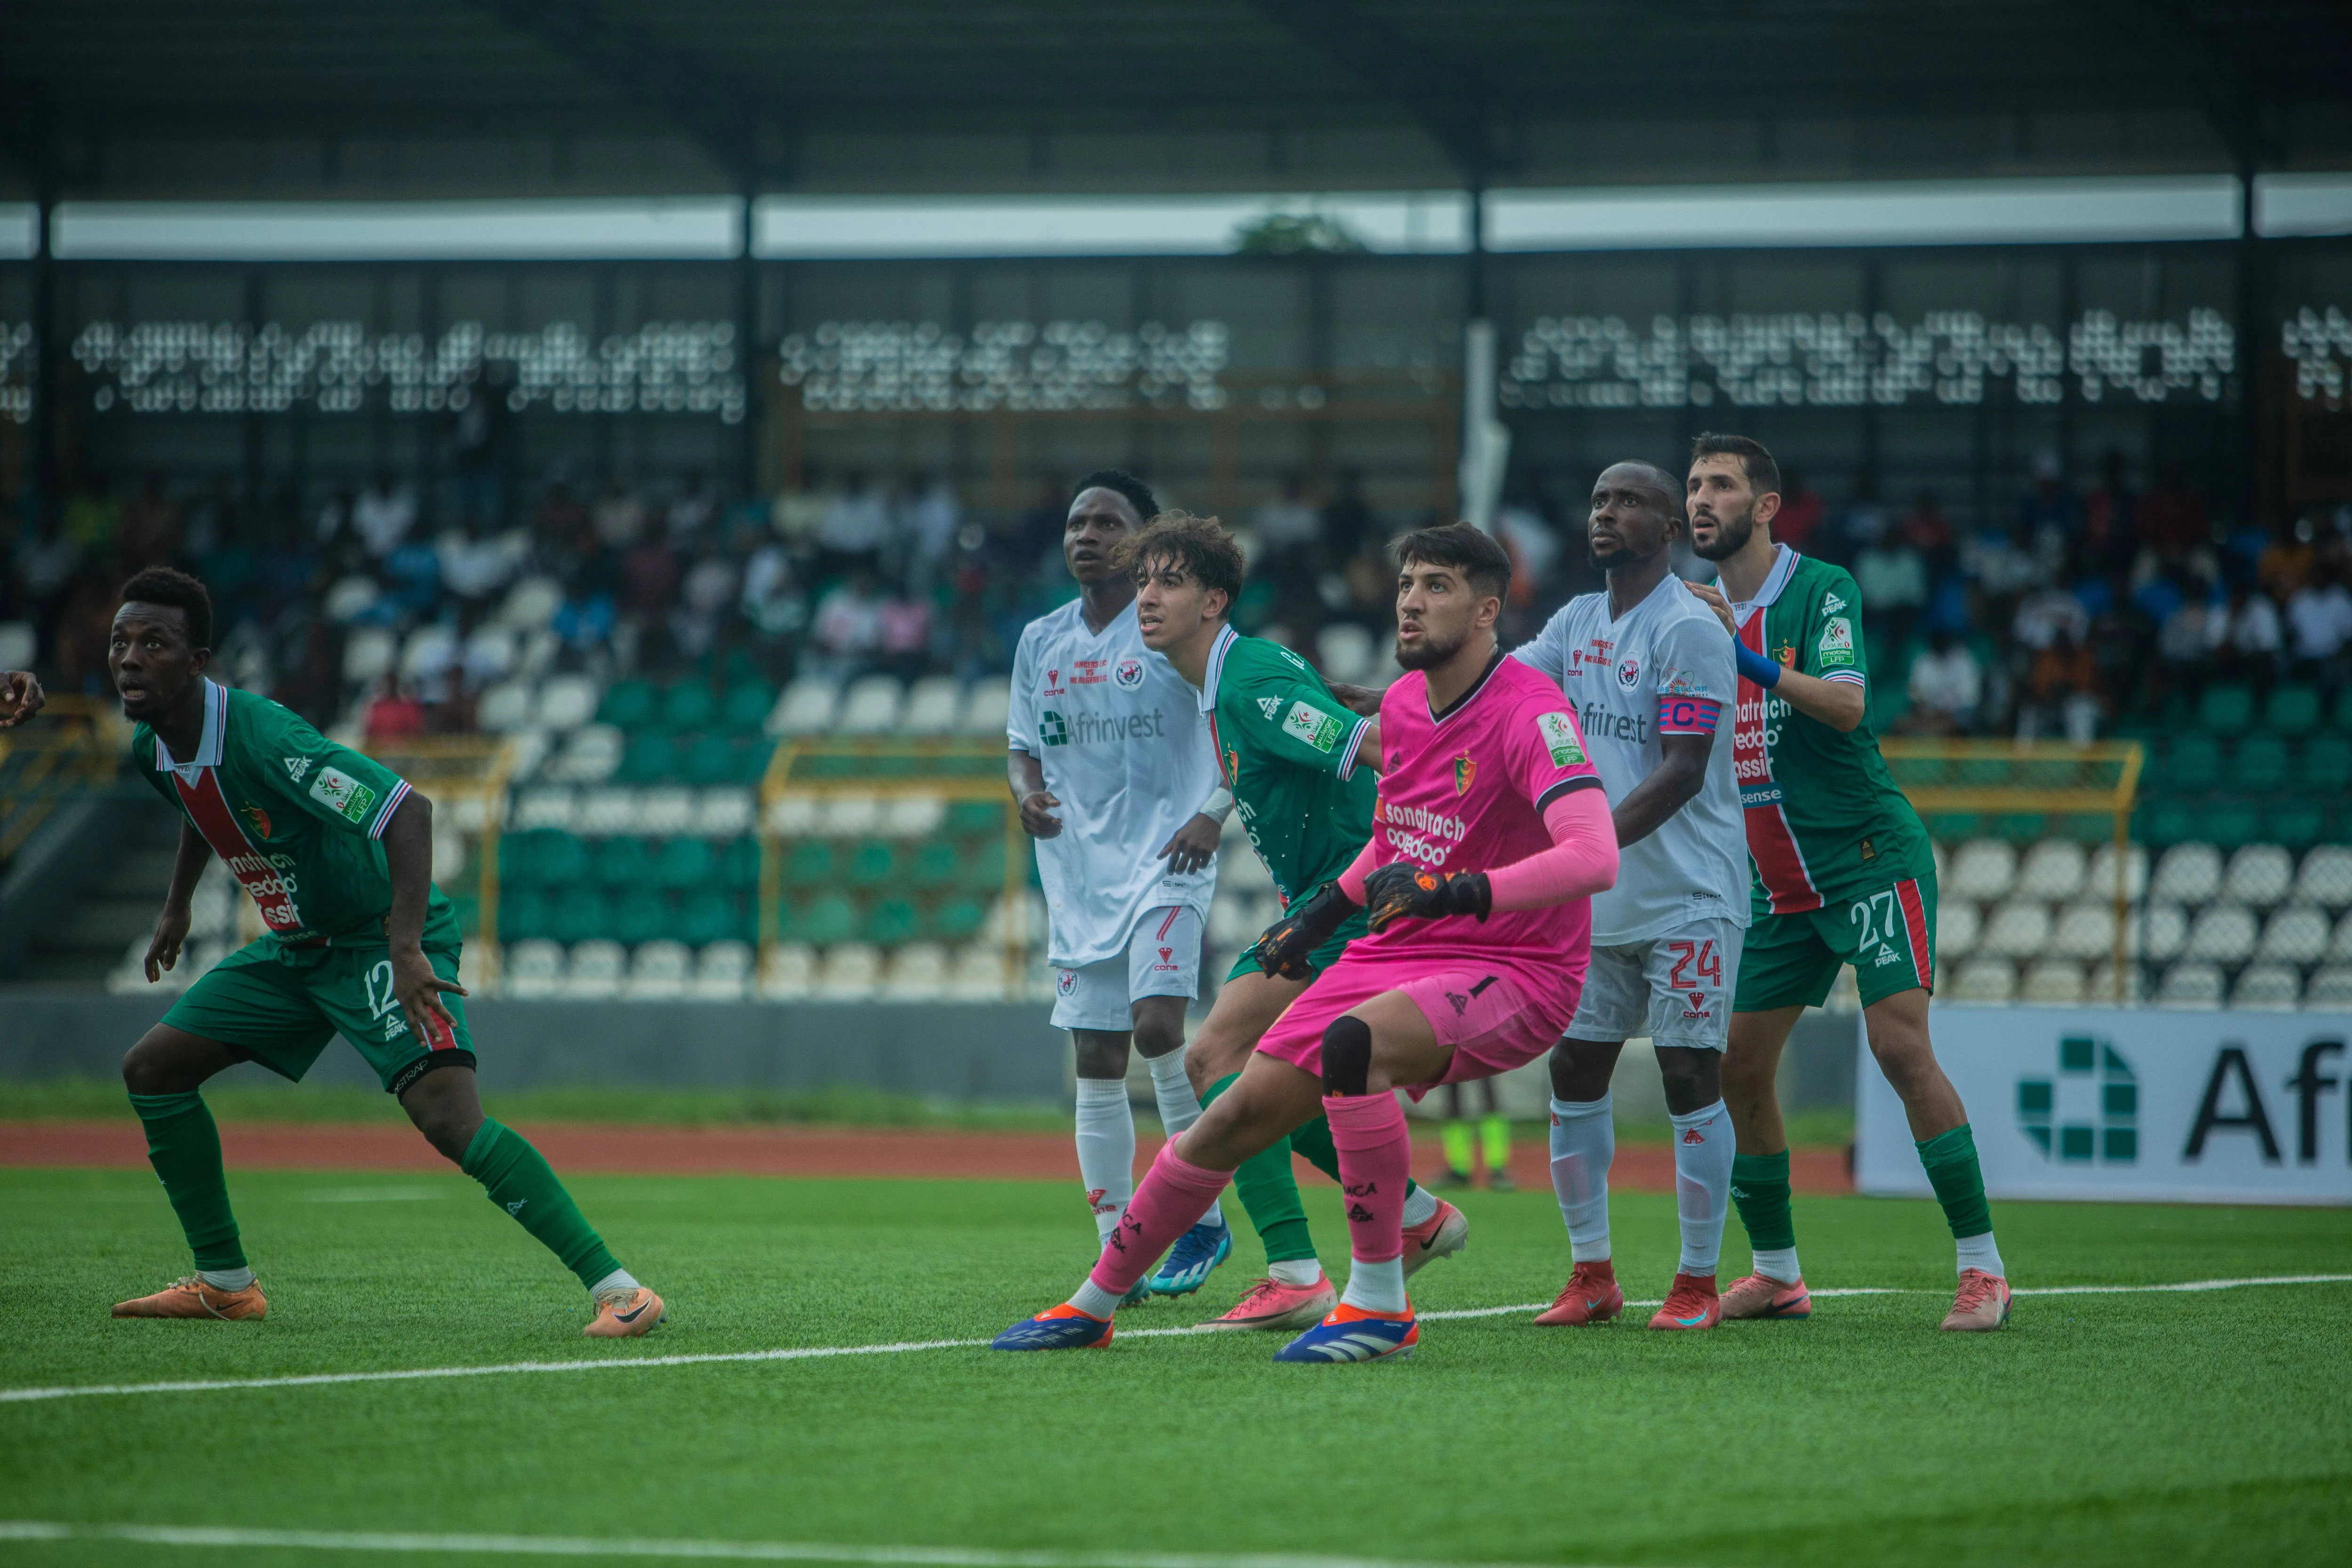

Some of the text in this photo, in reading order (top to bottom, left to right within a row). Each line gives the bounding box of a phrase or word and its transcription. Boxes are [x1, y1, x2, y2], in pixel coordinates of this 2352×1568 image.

[1734, 603, 1747, 611] 1921
[1821, 600, 1847, 617] PEAK
[1264, 695, 1284, 721] PEAK
[1672, 703, 1695, 726] C
[1066, 708, 1164, 745] Afrinvest
[1326, 729, 1336, 744] LFP
[290, 755, 312, 783] PEAK
[356, 798, 368, 814] LFP
[1741, 789, 1782, 804] sense
[1385, 804, 1465, 842] sonatrach
[1851, 890, 1894, 953] 27
[1669, 940, 1721, 989] 24
[1875, 952, 1902, 968] PEAK
[364, 960, 400, 1021] 12
[384, 1020, 409, 1042] PEAK
[2181, 1039, 2352, 1164] Af
[1121, 1204, 1142, 1235] CA
